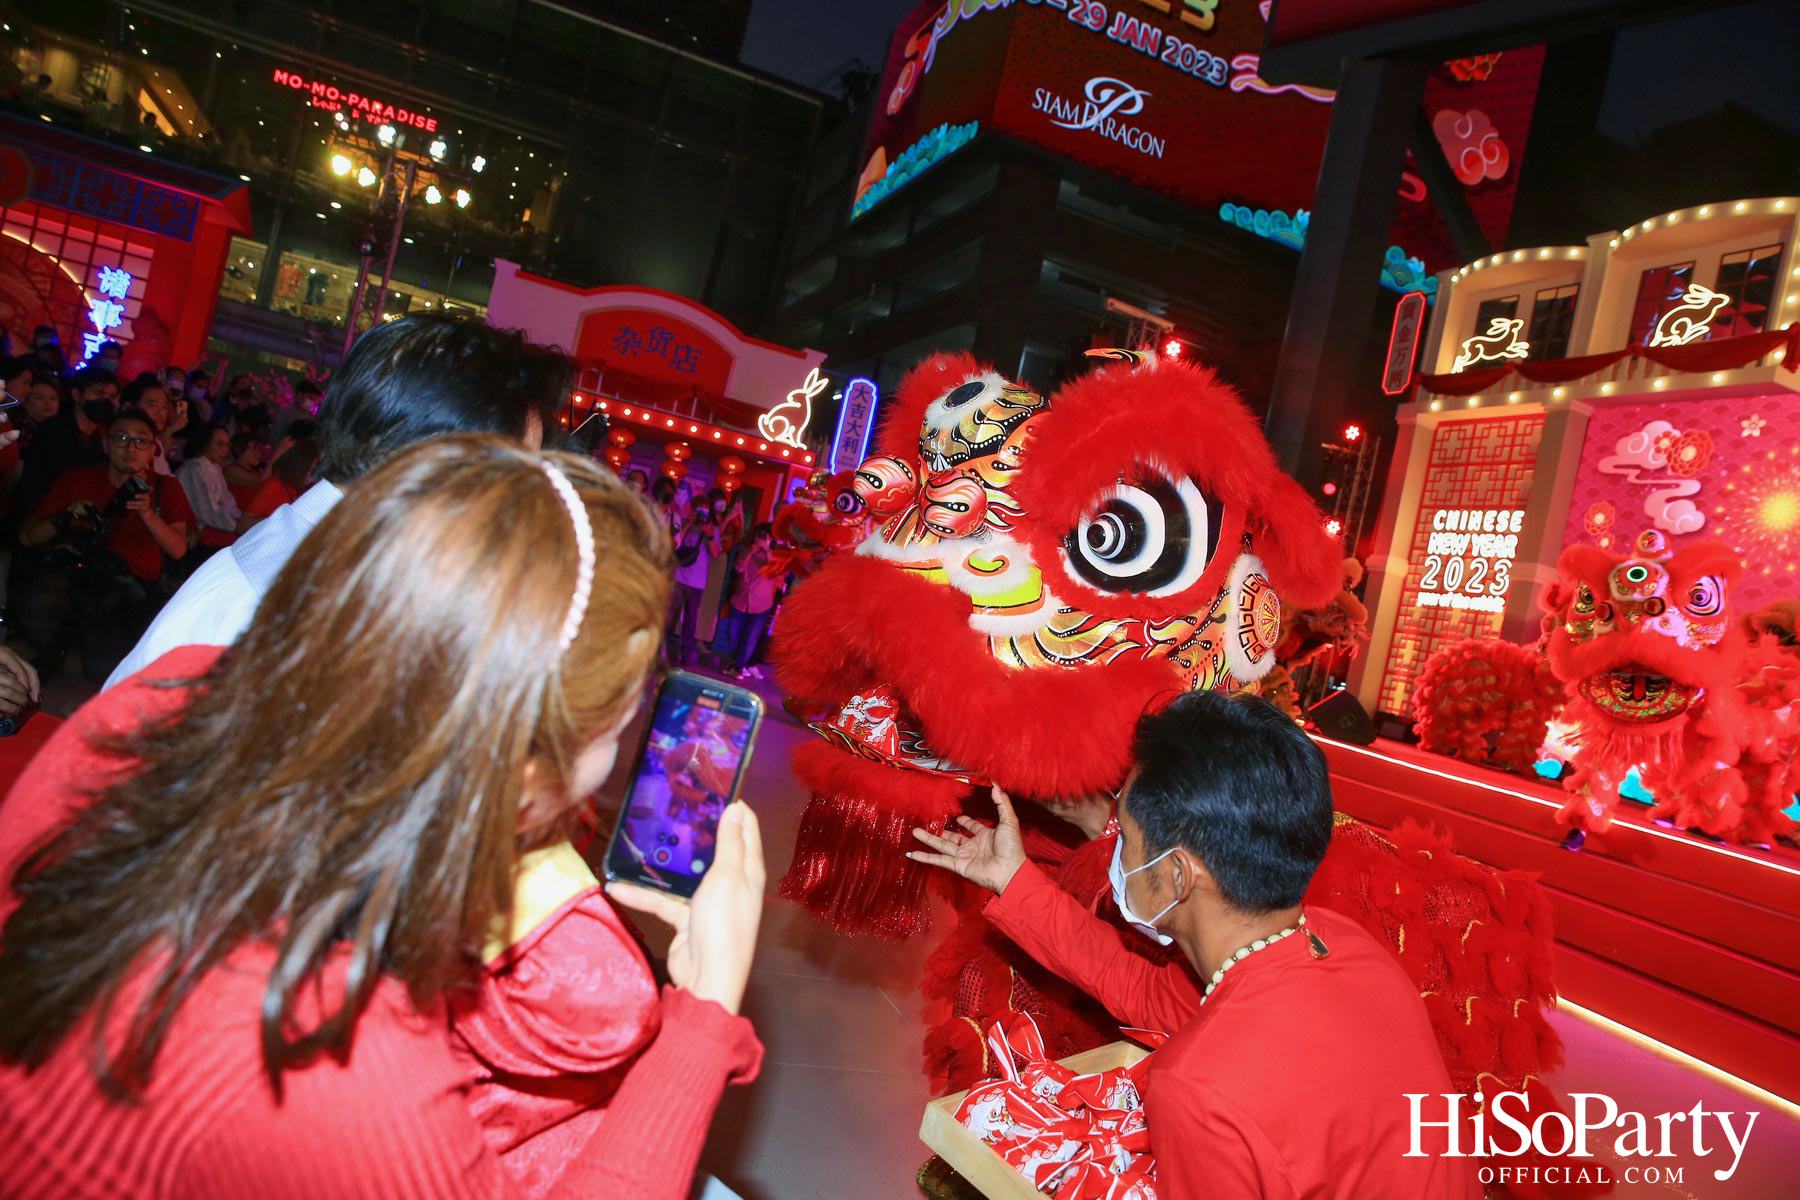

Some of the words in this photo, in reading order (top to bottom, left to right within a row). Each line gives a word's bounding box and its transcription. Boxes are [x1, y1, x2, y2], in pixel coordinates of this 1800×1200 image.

[1068, 0, 1107, 31] 29
[1107, 11, 1161, 57] JAN
[1161, 36, 1229, 87] 2023
[273, 69, 438, 133] MO-MO-PARADISE
[1031, 87, 1080, 125] SIAM
[610, 326, 703, 375] 杂货店
[842, 384, 871, 454] 大吉大利
[1433, 509, 1525, 533] CHINESE
[1427, 532, 1471, 555] NEW
[1471, 533, 1519, 559] YEAR
[1420, 555, 1513, 596] 2023
